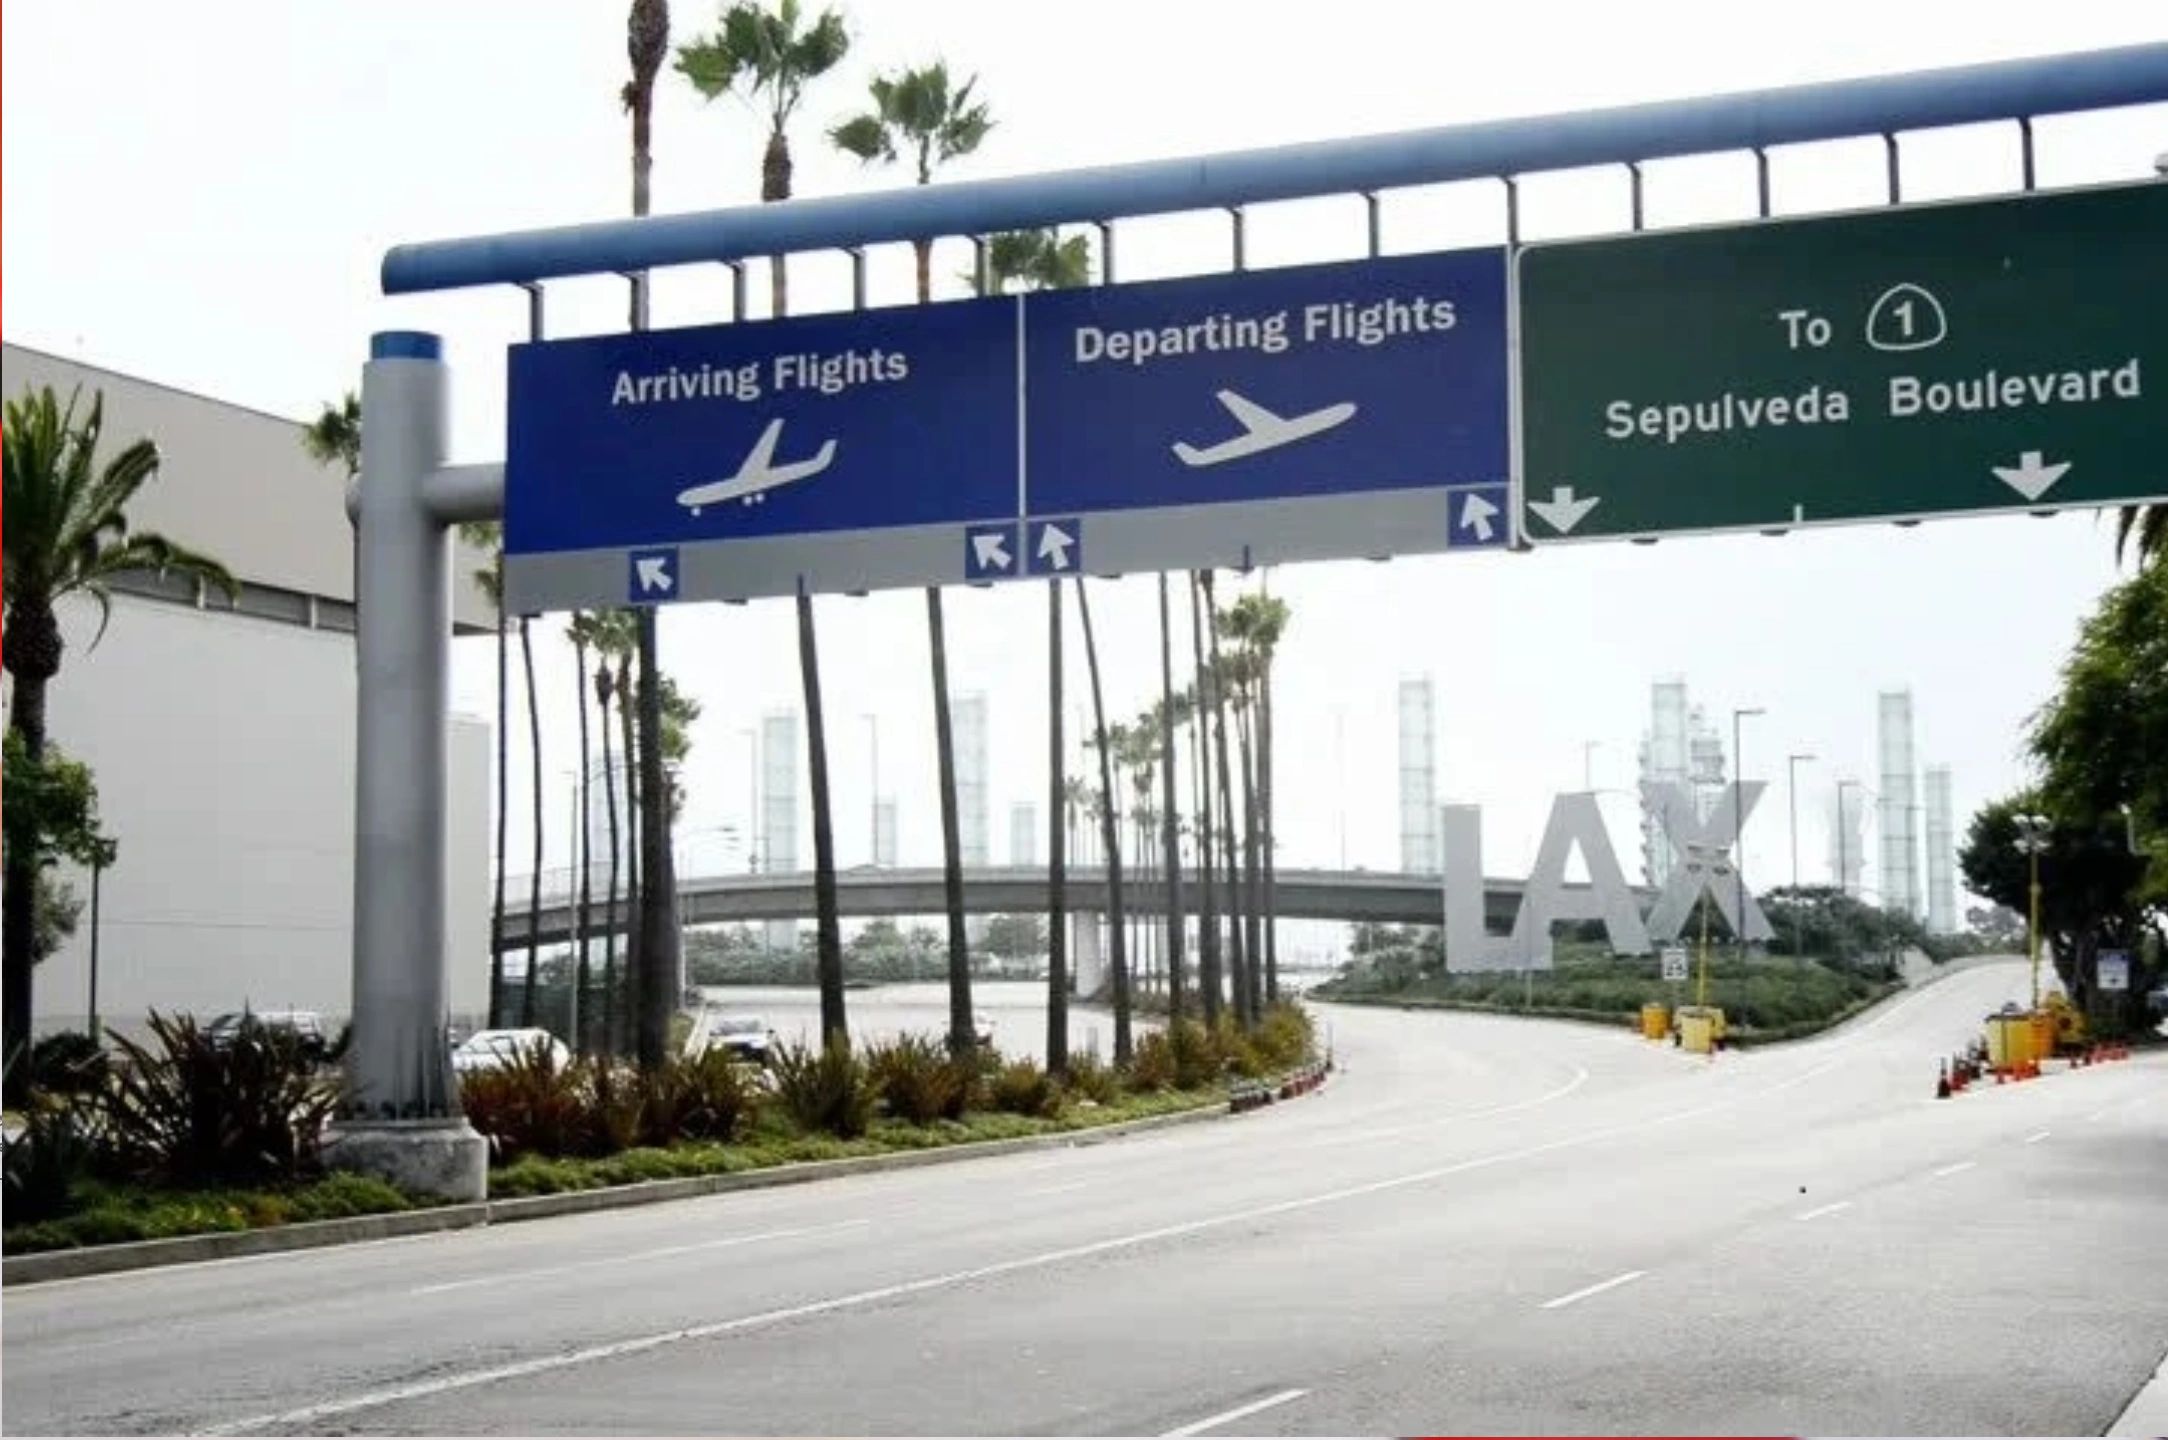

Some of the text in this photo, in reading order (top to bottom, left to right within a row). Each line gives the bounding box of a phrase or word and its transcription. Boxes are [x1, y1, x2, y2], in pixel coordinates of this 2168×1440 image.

[1075, 296, 1457, 366] Departing Flights
[1779, 301, 1914, 349] To 1
[612, 349, 908, 406] Arriving Flights
[1605, 358, 2141, 443] Sepulveda Boulevard
[1442, 780, 1776, 974] LAX
